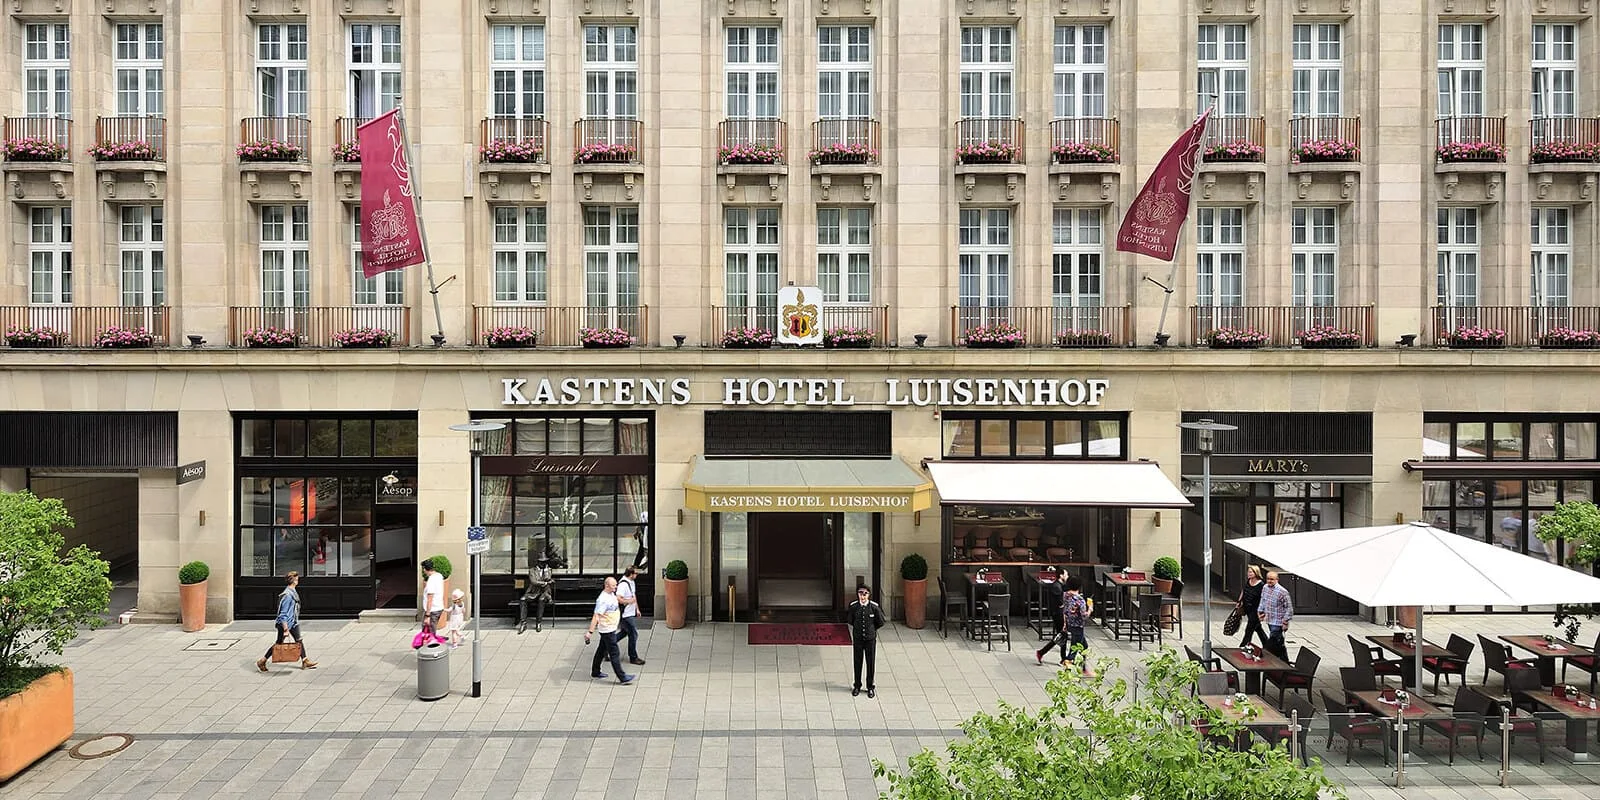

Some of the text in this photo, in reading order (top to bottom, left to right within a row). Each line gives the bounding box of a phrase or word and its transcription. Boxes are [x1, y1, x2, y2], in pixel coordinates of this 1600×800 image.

[501, 378, 1110, 406] KASTENS HOTEL LUISENHOF
[528, 458, 601, 474] Luisenhof
[1248, 459, 1309, 473] MARY's
[710, 496, 910, 507] KASTENS HOTEL LUISENHOF
